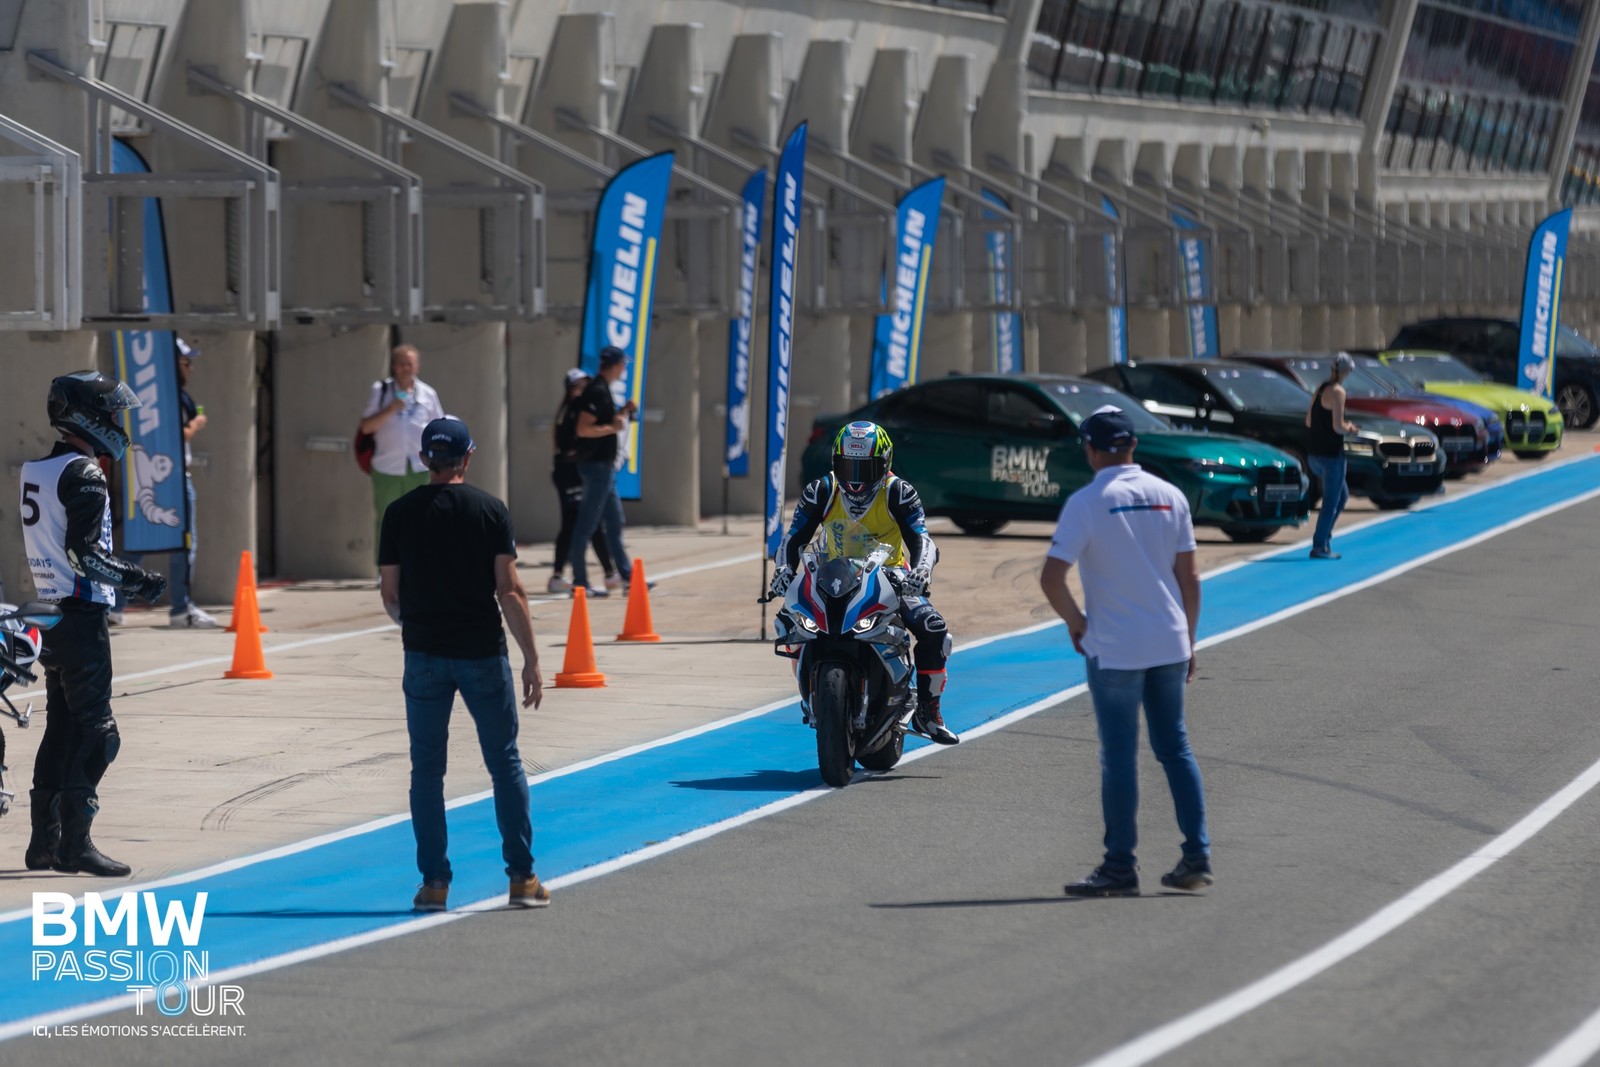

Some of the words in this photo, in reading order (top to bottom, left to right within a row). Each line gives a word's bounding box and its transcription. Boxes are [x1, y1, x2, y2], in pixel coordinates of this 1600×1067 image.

[607, 191, 648, 409] MCHELIN
[735, 201, 759, 393] MICHELIN
[775, 172, 798, 440] MICHELIN
[886, 208, 927, 379] MICHELIN
[1531, 230, 1558, 358] MICHELIN
[22, 482, 40, 526] 5
[991, 468, 1049, 485] PASSION
[992, 445, 1050, 471] BMW
[1022, 482, 1061, 497] TOUR
